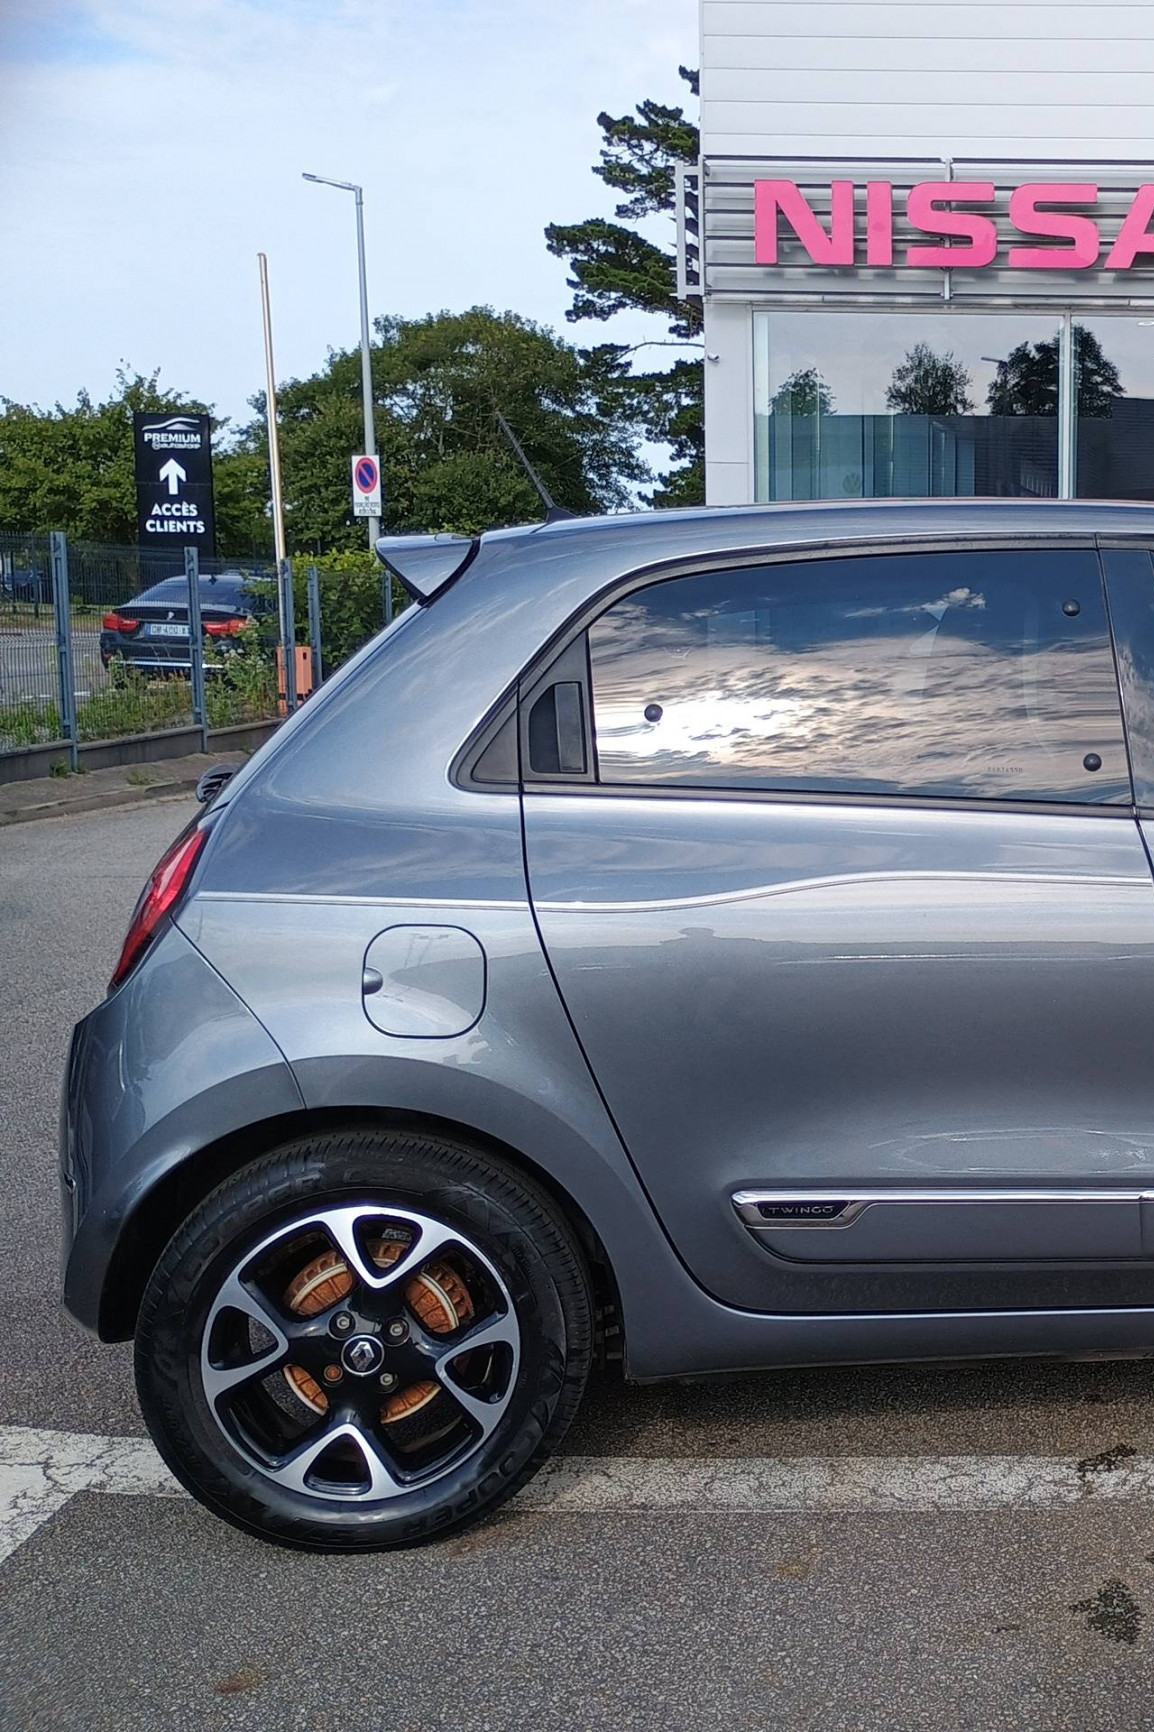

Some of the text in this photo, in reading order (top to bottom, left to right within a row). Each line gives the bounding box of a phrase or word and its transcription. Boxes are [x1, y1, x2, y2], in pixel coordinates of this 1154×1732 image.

[143, 432, 201, 443] PREMIUM
[150, 501, 198, 516] ACCÈS
[145, 519, 206, 534] CLIENTS
[768, 1205, 835, 1215] TWINGO
